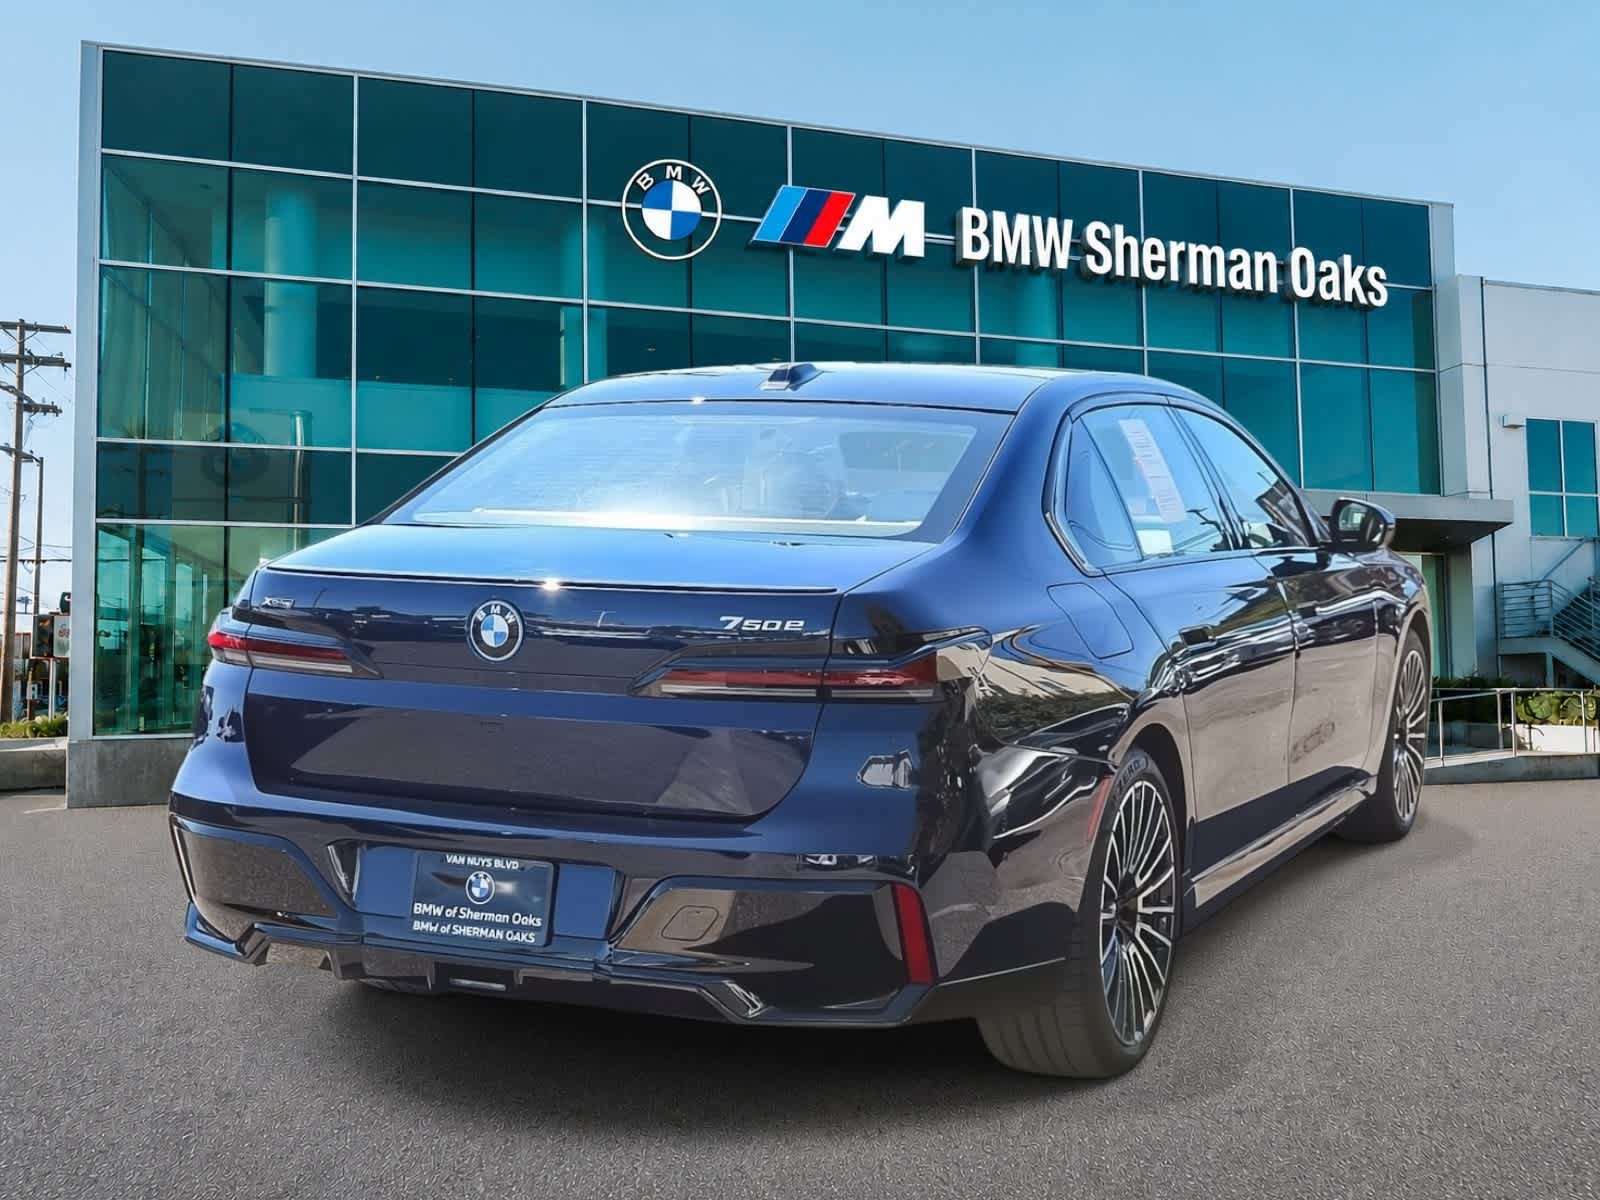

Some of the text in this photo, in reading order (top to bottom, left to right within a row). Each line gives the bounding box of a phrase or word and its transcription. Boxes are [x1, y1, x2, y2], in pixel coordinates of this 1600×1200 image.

[636, 165, 711, 196] BMW
[835, 195, 925, 258] M
[958, 206, 1388, 308] BMW Sherman Oaks
[475, 604, 516, 624] BMW
[446, 854, 519, 869] VAN NUYS BLVD
[413, 902, 542, 927] BMW of Sherman Oaks
[412, 920, 536, 943] BMW of SHERMAN OAKS
